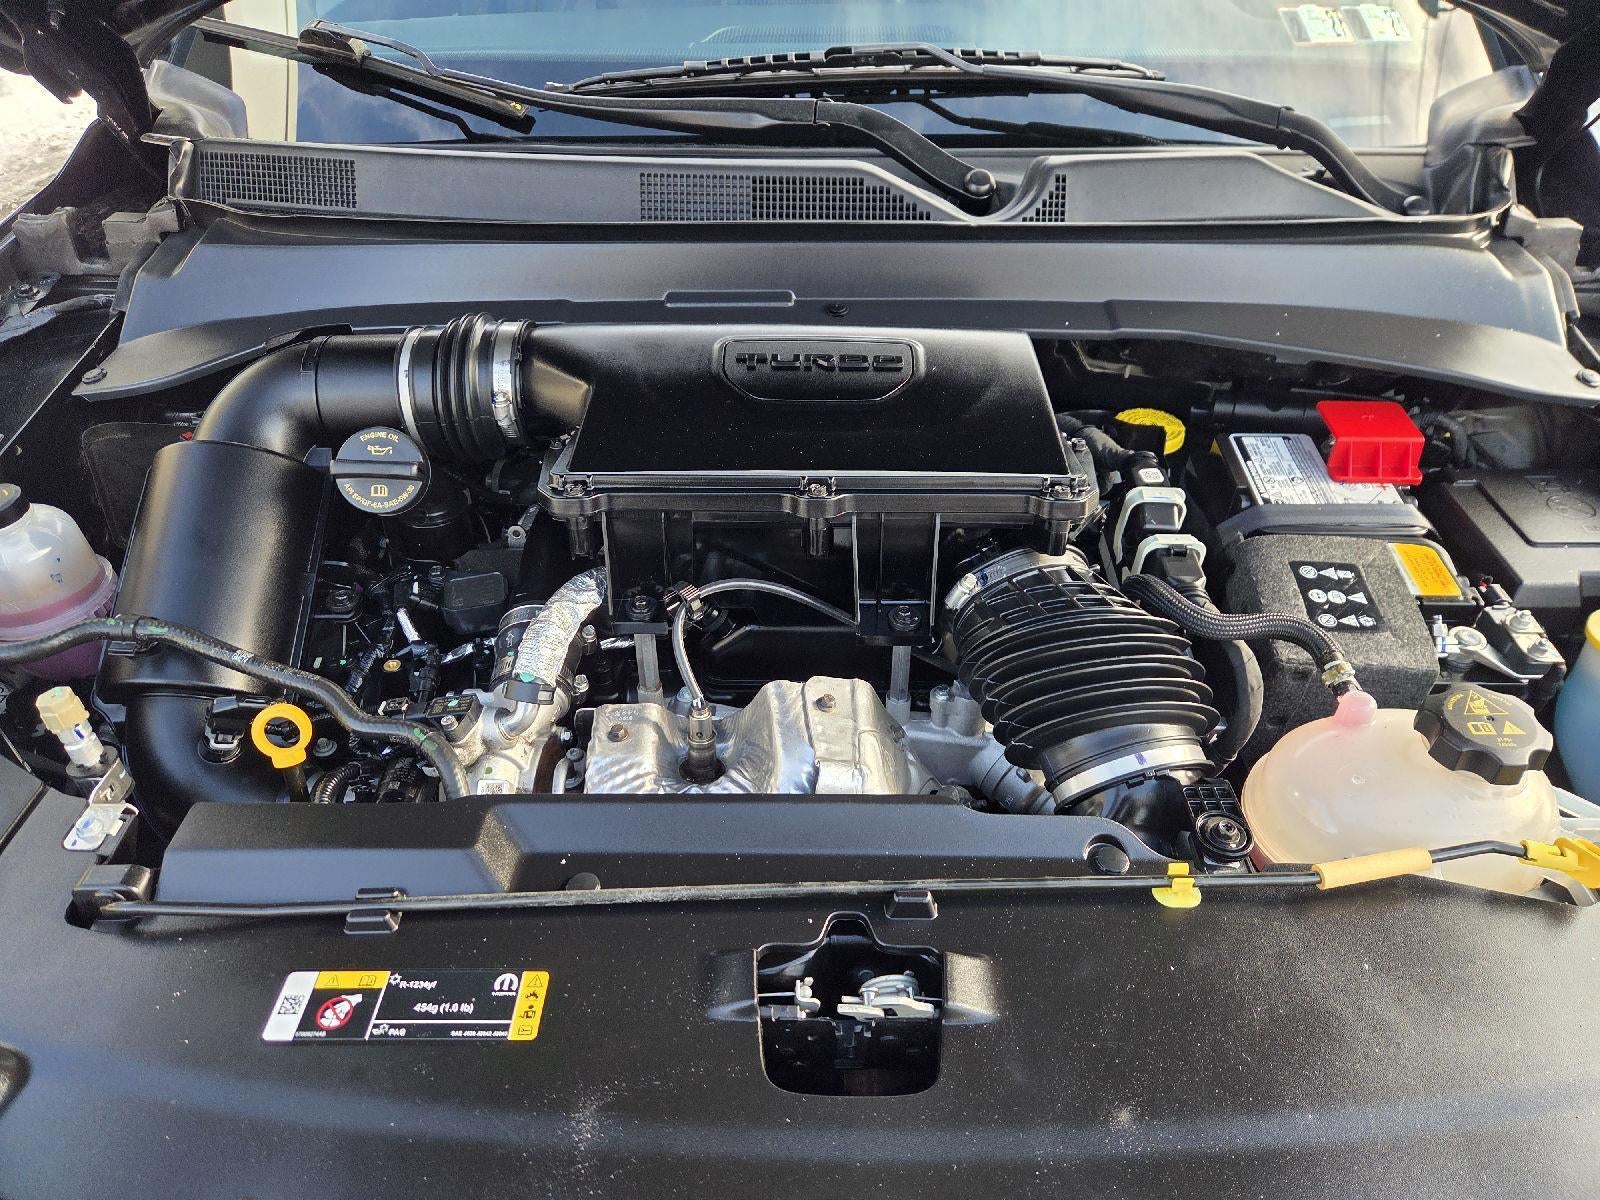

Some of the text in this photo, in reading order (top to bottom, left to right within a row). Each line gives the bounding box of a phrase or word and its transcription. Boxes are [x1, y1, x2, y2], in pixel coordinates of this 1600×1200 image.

[735, 352, 905, 372] TURBO
[360, 431, 399, 443] ENGINE OIL
